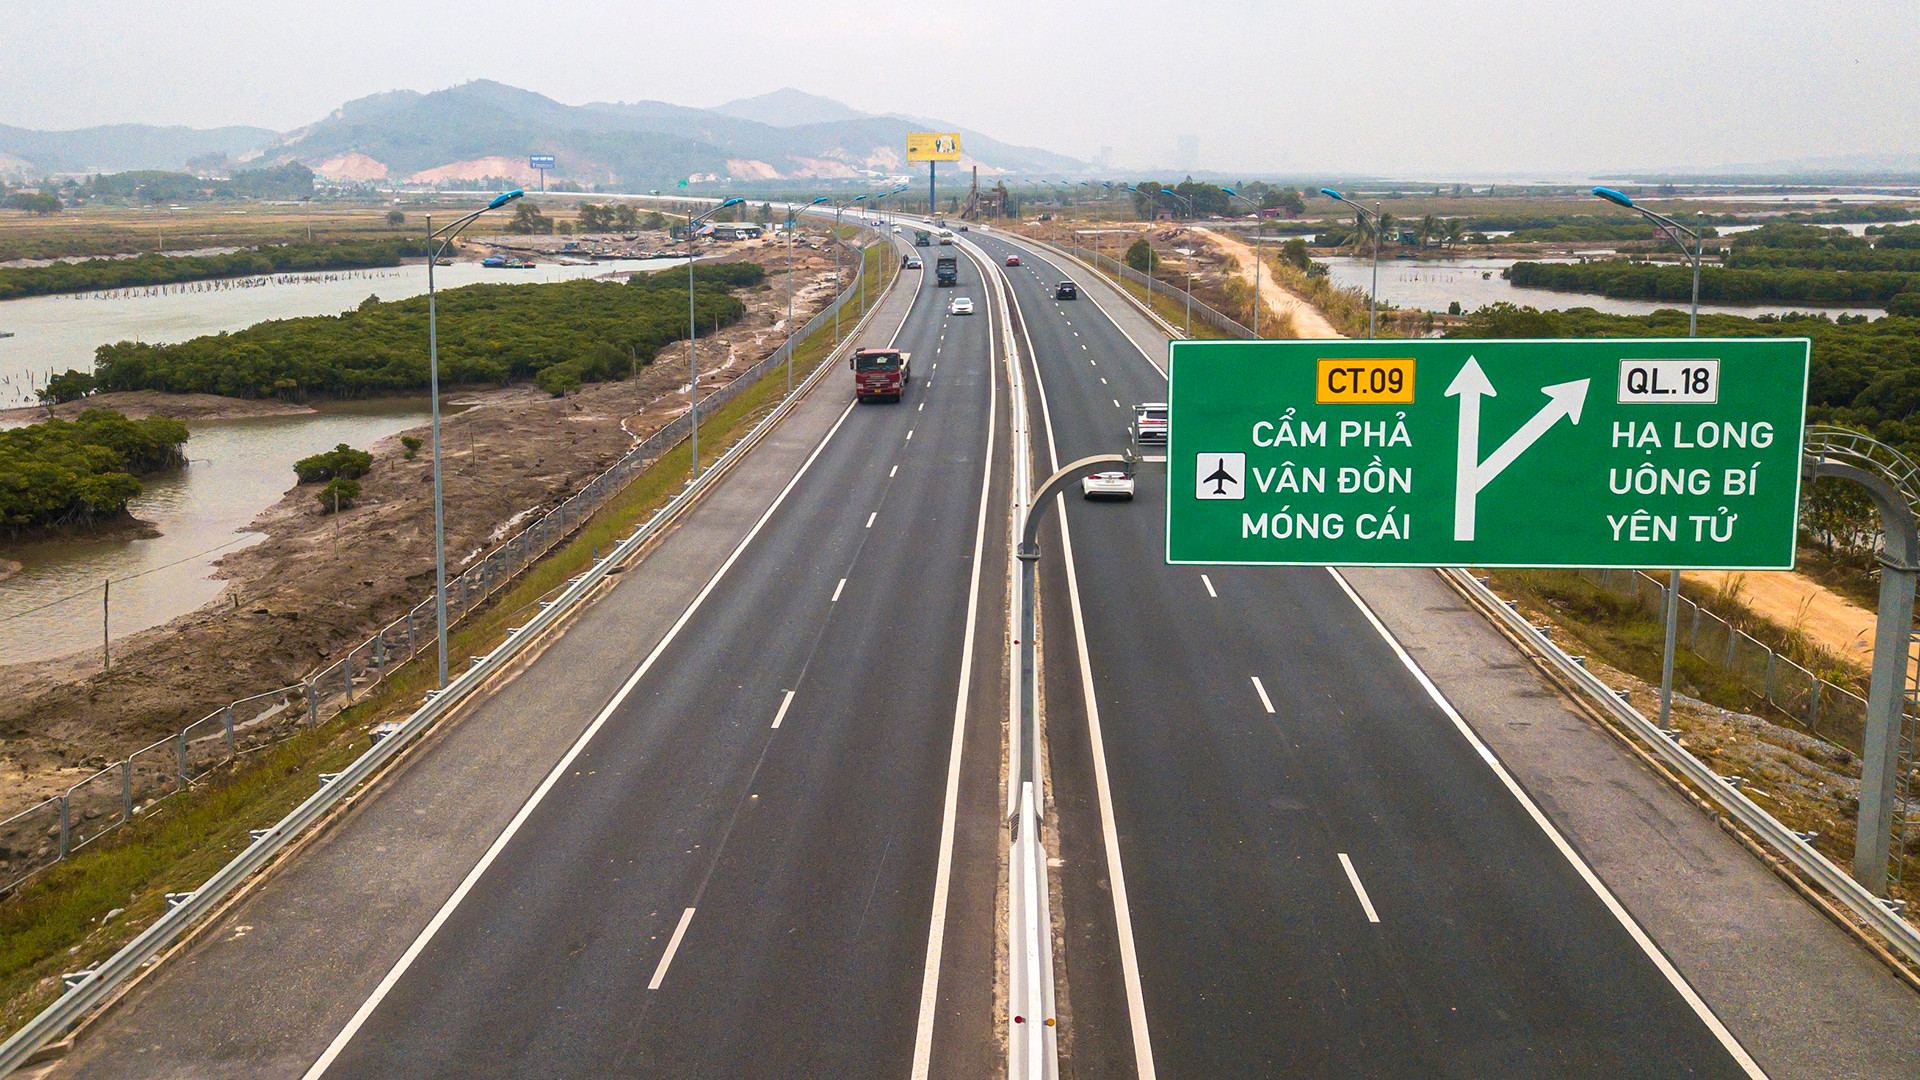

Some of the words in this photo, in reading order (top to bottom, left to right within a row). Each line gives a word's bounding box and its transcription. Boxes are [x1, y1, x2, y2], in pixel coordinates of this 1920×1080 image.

[1328, 367, 1403, 394] CT.09
[1627, 367, 1710, 395] QL.18
[1252, 407, 1327, 447] CẨM
[1340, 411, 1413, 447] PHẢ
[1612, 421, 1662, 455] HẠ
[1674, 421, 1774, 449] LONG
[1252, 460, 1326, 493] VÂN
[1337, 454, 1412, 494] ĐỒN
[1609, 461, 1711, 496] UÔNG
[1723, 461, 1762, 496] BÍ
[1242, 505, 1344, 540] MÓNG
[1355, 505, 1410, 540] CÁI
[1606, 508, 1677, 542] YÊN
[1688, 506, 1739, 543] TỬ
